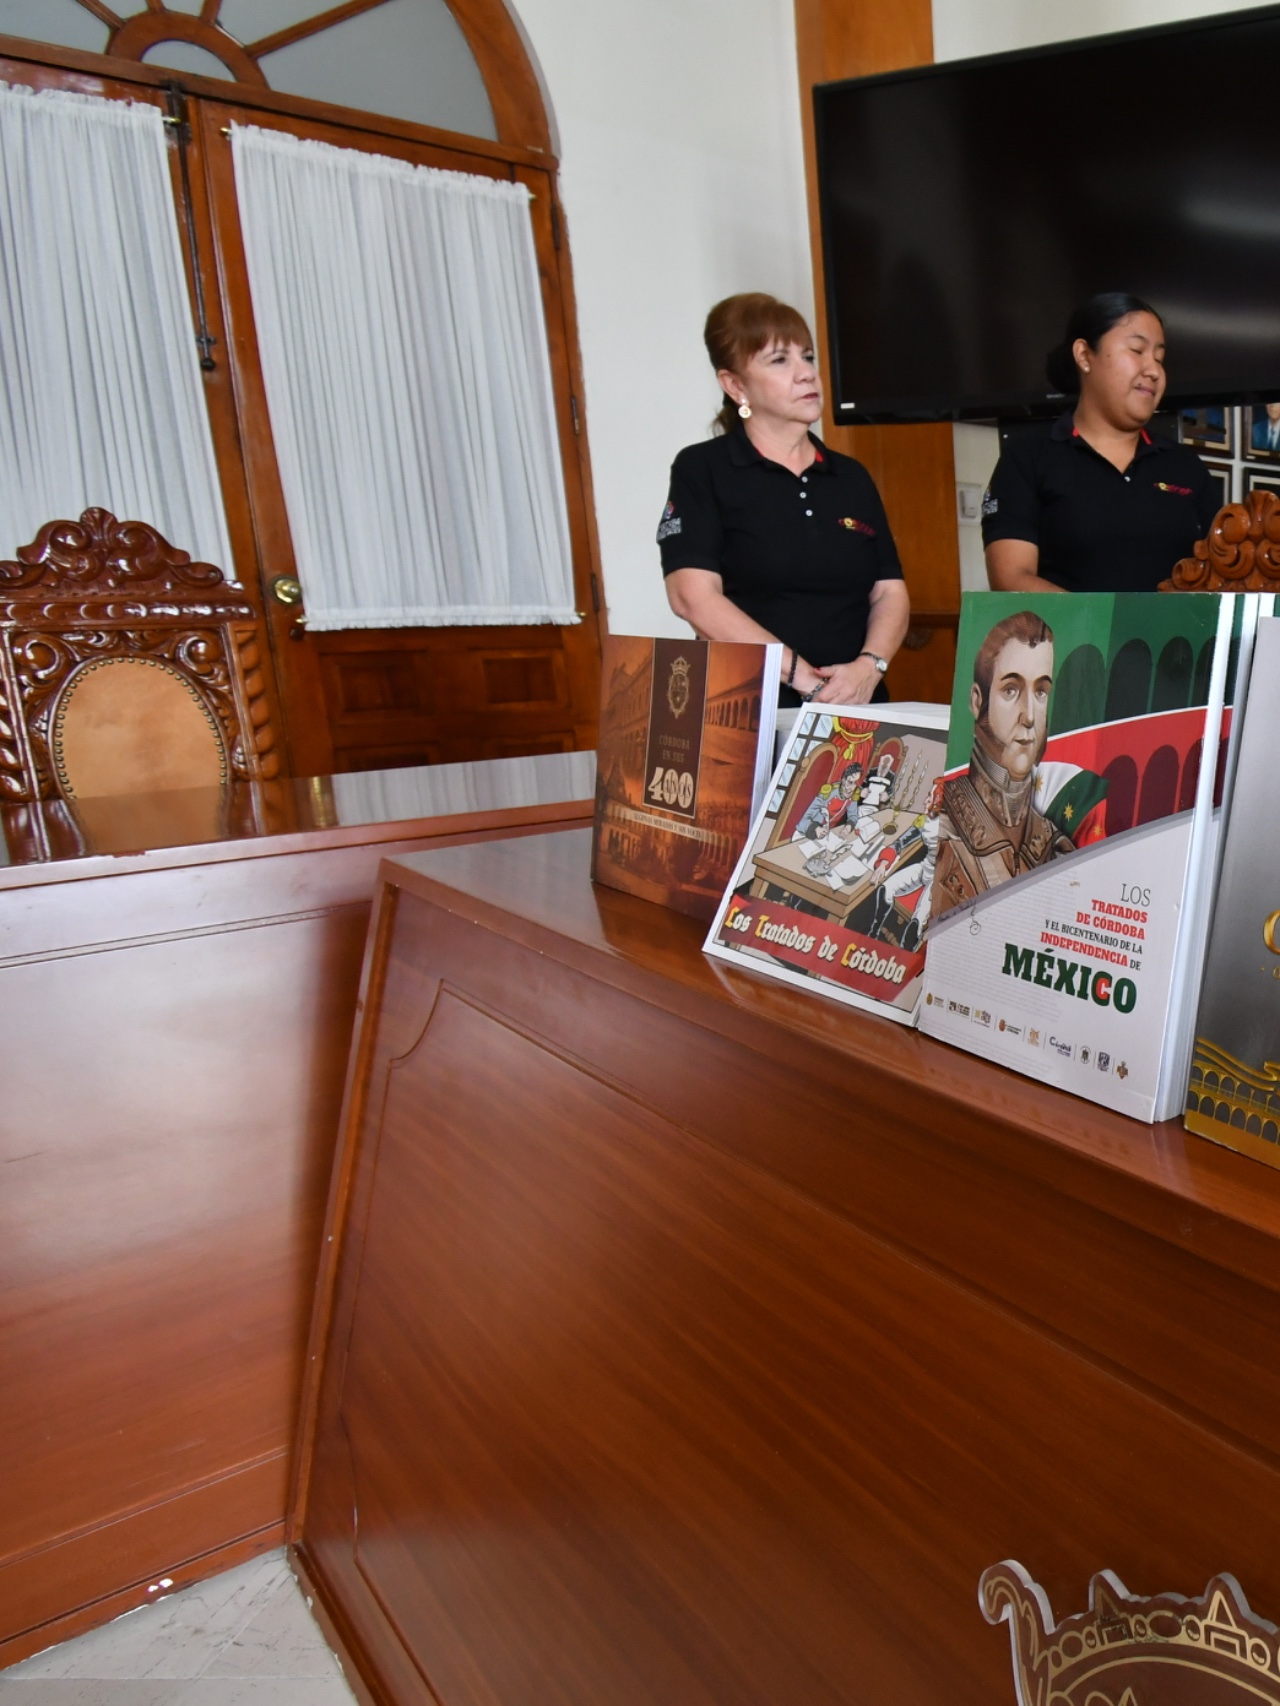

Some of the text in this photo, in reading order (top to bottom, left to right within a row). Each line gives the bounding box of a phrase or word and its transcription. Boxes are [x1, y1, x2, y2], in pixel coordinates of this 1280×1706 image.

[648, 767, 694, 809] 400
[1091, 899, 1148, 923] TRATADOS
[1120, 883, 1151, 907] LOS
[1045, 919, 1143, 954] Y EL BICENTENARIO DE LA
[1076, 911, 1145, 940] DE CÓRDOBA
[725, 906, 906, 984] Los Tratados de Córdoba
[1040, 931, 1141, 971] INDEPENDENCIA DE
[1002, 942, 1137, 1014] MÉXICO
